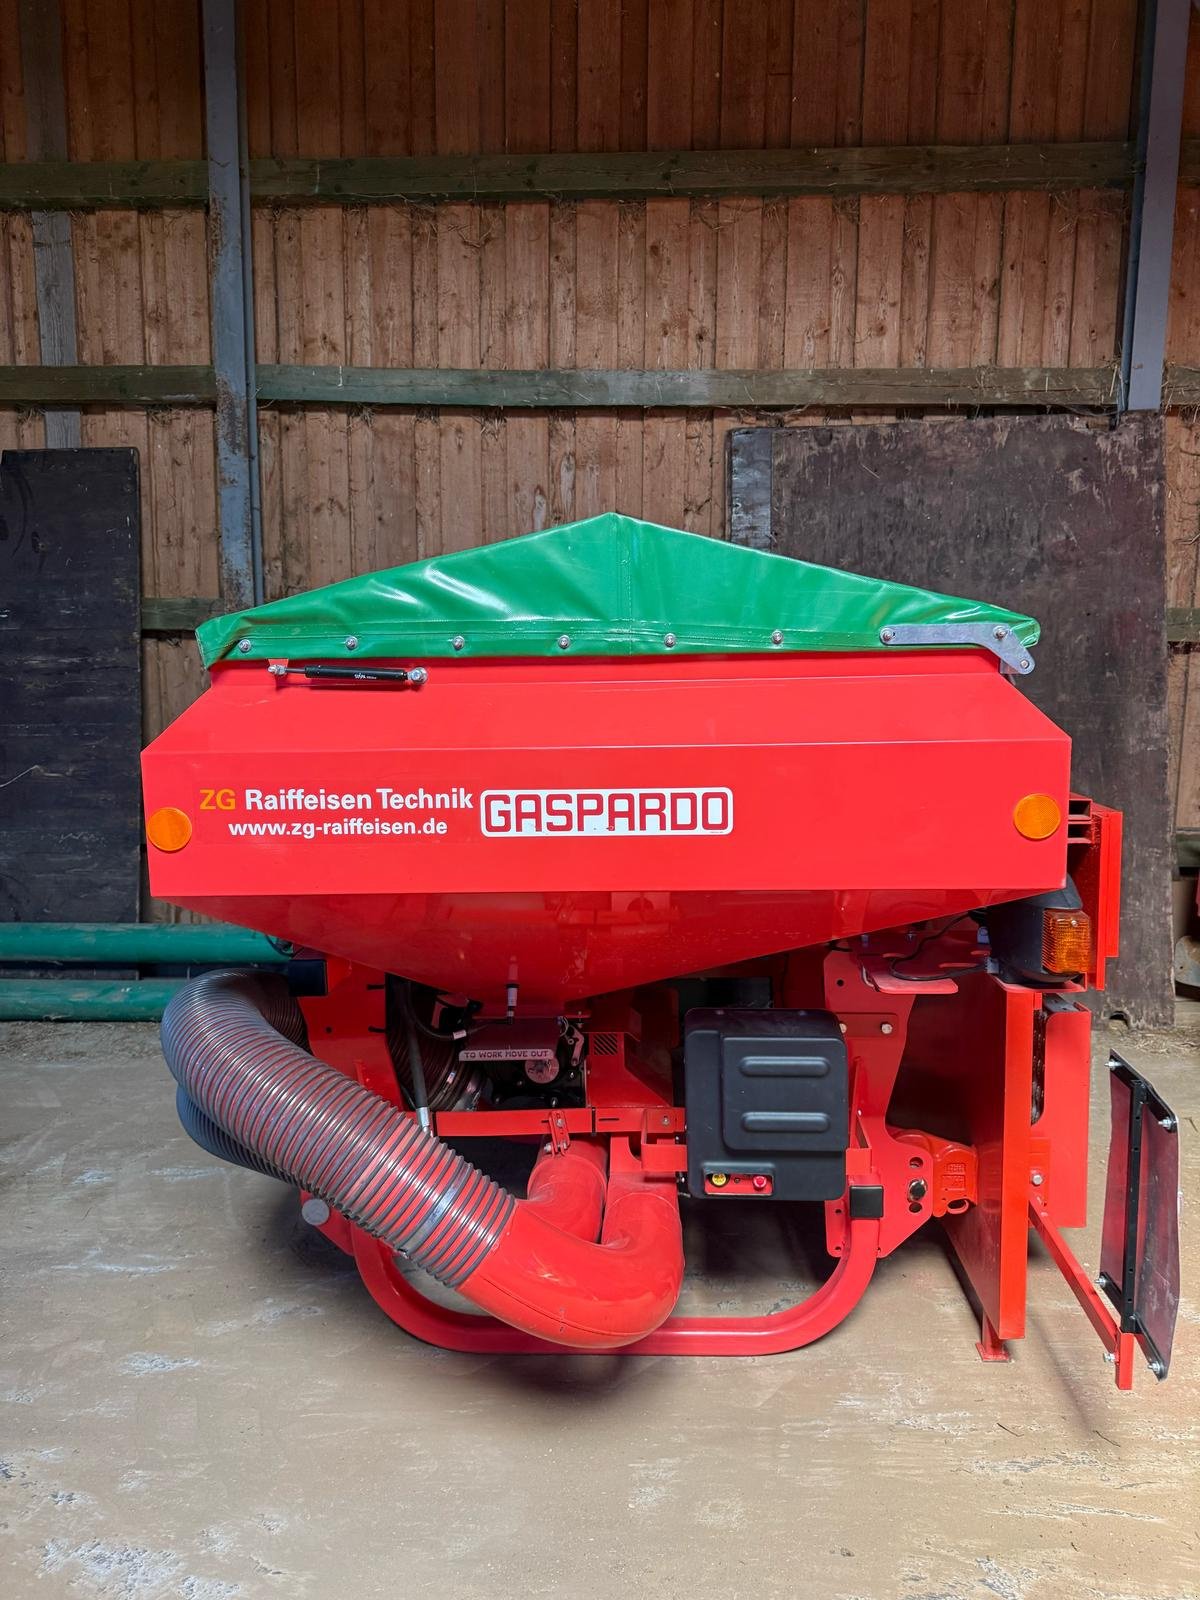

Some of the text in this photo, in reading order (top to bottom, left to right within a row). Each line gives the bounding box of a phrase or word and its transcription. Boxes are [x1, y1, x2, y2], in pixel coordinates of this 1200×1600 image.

[199, 788, 474, 810] ZG Raiffeisen Technik
[484, 791, 729, 833] GASPARDO
[228, 818, 448, 839] www.zg-raiffeisen.de
[479, 1051, 503, 1059] WORK
[530, 1050, 549, 1058] OUT
